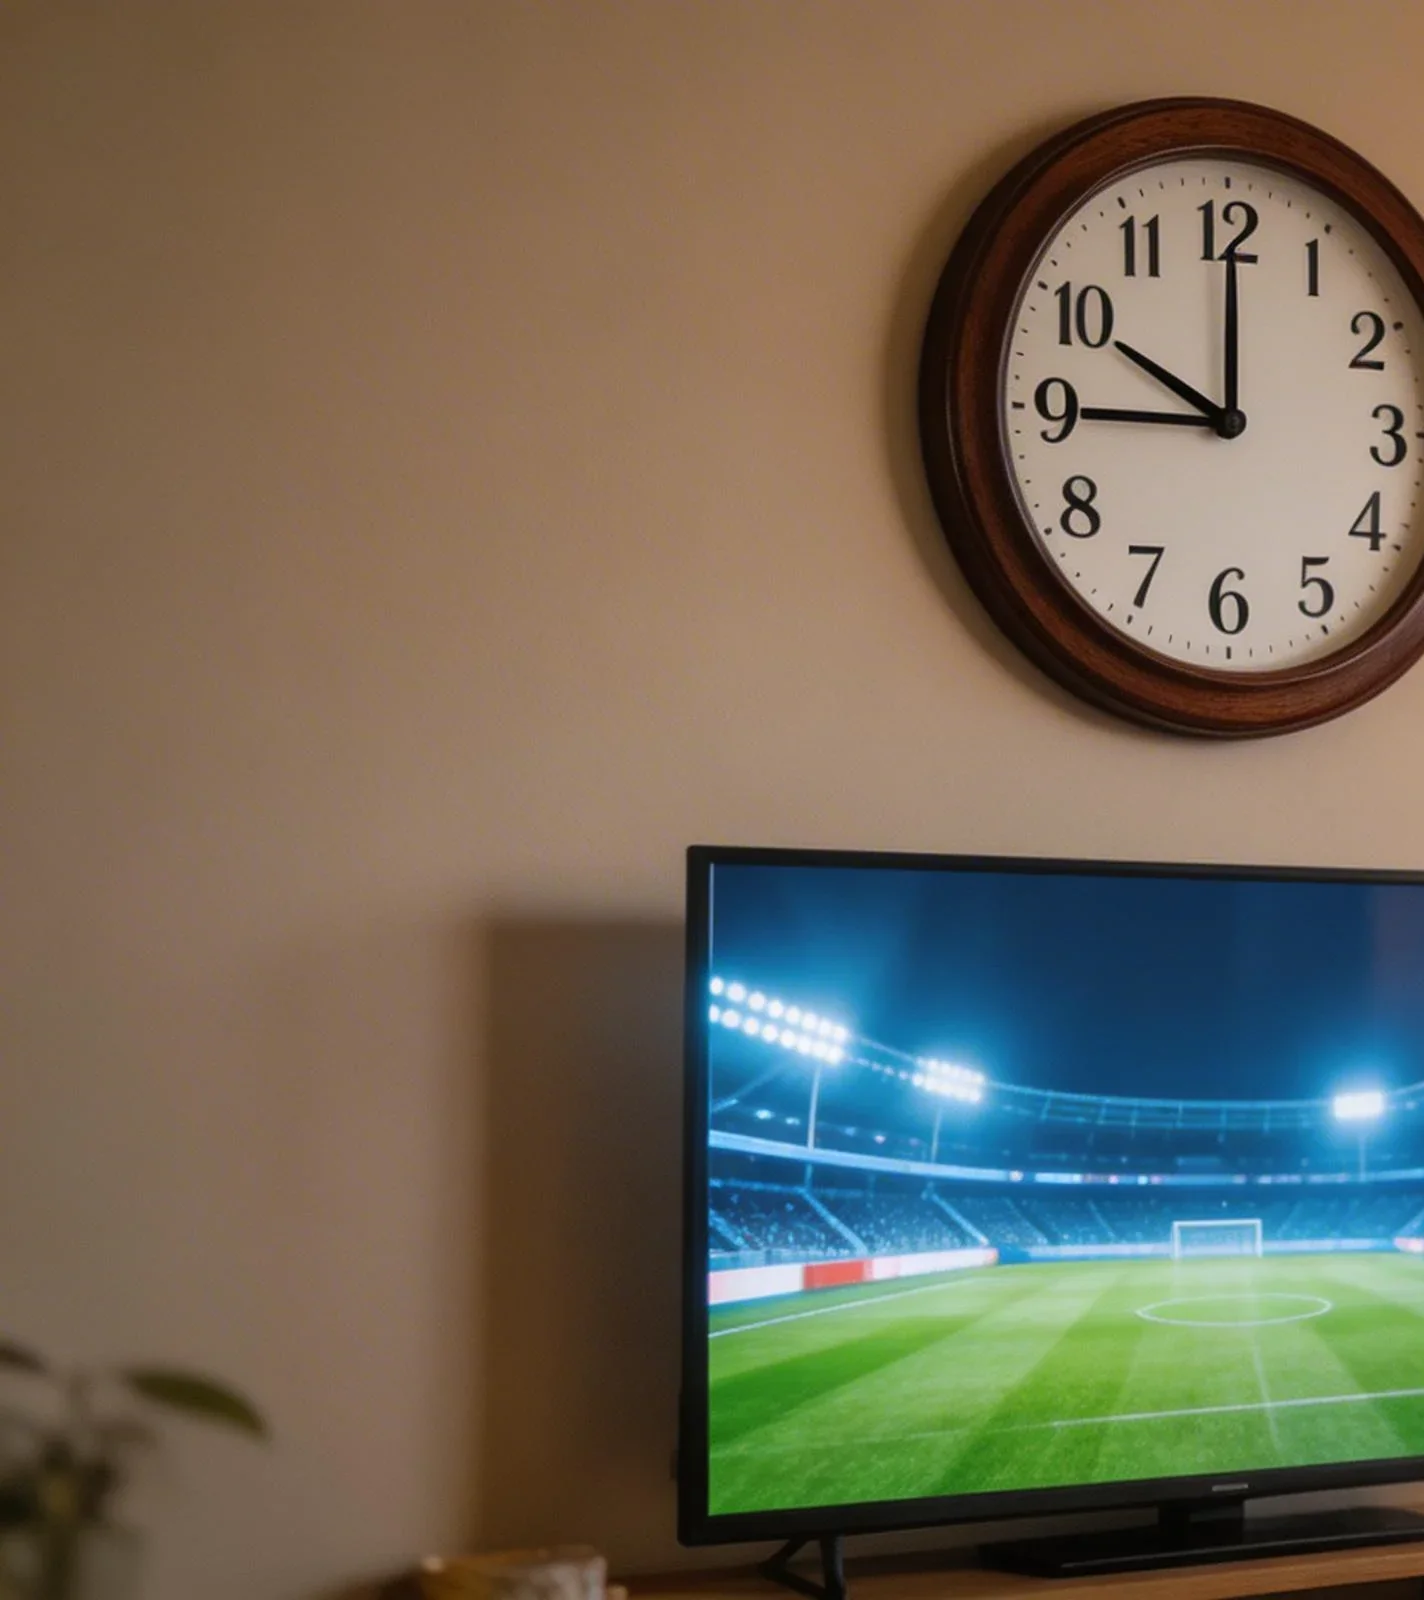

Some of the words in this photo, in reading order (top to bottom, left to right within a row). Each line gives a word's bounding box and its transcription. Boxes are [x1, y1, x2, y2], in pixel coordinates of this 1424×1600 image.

[1119, 214, 1160, 278] 11
[1197, 199, 1259, 265] 12
[1304, 237, 1320, 297] 1
[1053, 281, 1114, 349] 10
[1348, 310, 1387, 371] 2
[1033, 377, 1079, 443] 9
[1369, 404, 1407, 467] 3
[1060, 475, 1101, 538] 8
[1348, 491, 1387, 552] 4
[1128, 545, 1165, 609] 7
[1208, 567, 1250, 635] 6
[1298, 556, 1335, 618] 5
